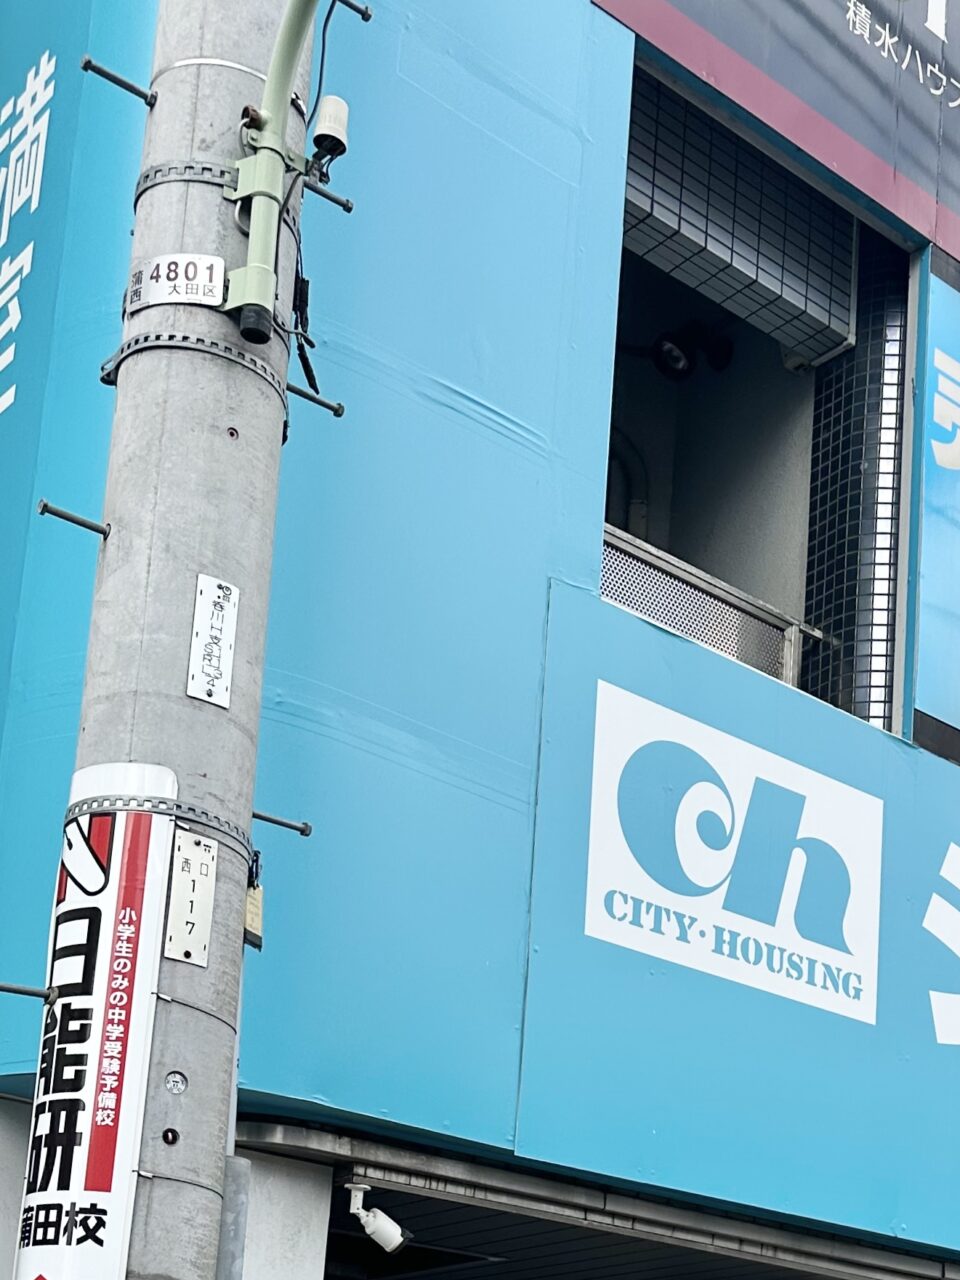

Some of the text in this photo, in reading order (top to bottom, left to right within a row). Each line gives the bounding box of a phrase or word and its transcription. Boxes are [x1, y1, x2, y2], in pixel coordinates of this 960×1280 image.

[150, 261, 214, 283] 4801
[168, 283, 217, 297] 大田区
[95, 907, 138, 1127] 小学生のみの中学受験予備校
